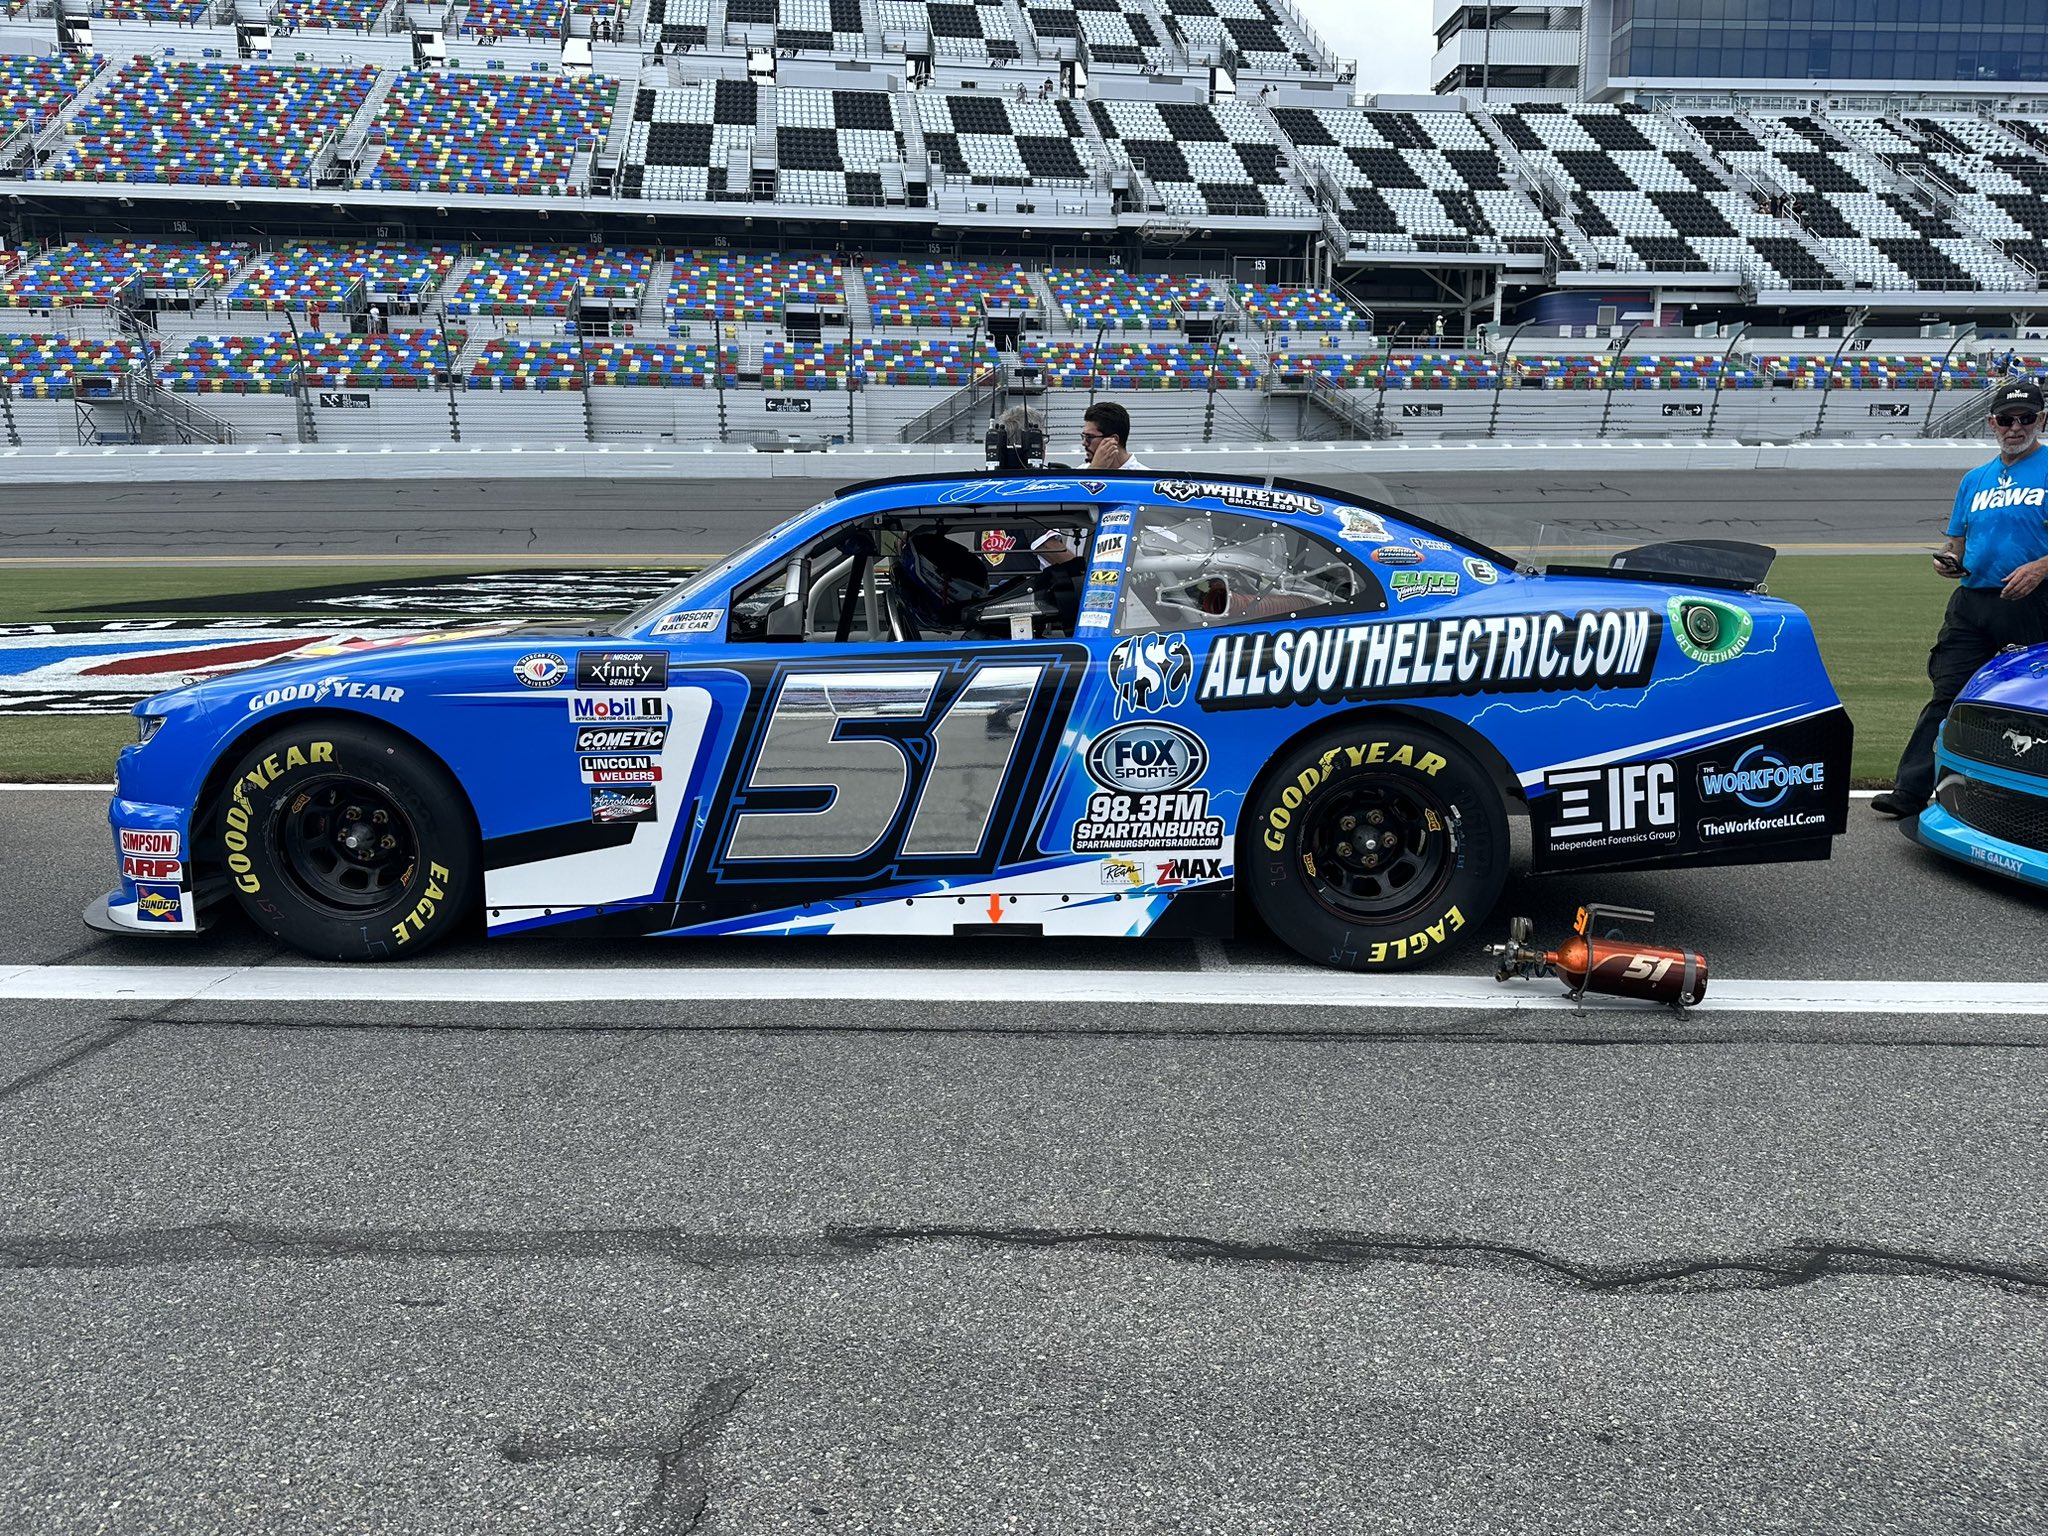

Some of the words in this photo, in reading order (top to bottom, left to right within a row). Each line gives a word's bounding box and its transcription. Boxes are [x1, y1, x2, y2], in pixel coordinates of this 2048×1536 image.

[481, 36, 494, 45] 363
[173, 221, 187, 232] 158
[376, 226, 389, 238] 157
[714, 236, 727, 247] 156
[928, 243, 941, 254] 155
[1109, 255, 1120, 265] 154
[1254, 260, 1266, 271] 153
[1854, 340, 1865, 350] 151
[342, 400, 368, 408] SECTIONS
[1201, 484, 1320, 511] WHITETAIL
[1228, 498, 1293, 511] SMOKELESS
[1971, 487, 2045, 512] Wawa
[1097, 536, 1122, 554] WIX
[1393, 573, 1457, 587] ELITE
[674, 612, 714, 622] NASCAR
[660, 623, 686, 631] RACE
[1201, 611, 1650, 699] ALLSOUTHELECTRIC.COM
[1676, 634, 1692, 652] GET
[1691, 636, 1749, 662] BIOETHANOL
[520, 674, 562, 687] ANNIVERSARY
[591, 662, 652, 682] xfinity
[574, 698, 635, 716] Mobil
[579, 731, 664, 747] COMETIC
[727, 666, 1042, 859] 51
[1115, 740, 1177, 767] FOX
[584, 758, 648, 770] LINCOLN
[1115, 767, 1178, 778] SPORTS
[599, 772, 655, 781] WELDERS
[1703, 763, 1825, 795] WORKFORCE
[592, 794, 654, 808] Arrowhead
[1608, 763, 1675, 831] IFG
[1091, 794, 1204, 822] 98.3FM
[1078, 821, 1219, 839] SPARTANBURG
[1704, 813, 1825, 836] TheWorkforceLLC.com
[123, 832, 172, 852] SIMPSON
[1076, 838, 1219, 849] SPARTANBURGSPORTSRADIO.COM
[1550, 838, 1606, 852] Independent
[1608, 833, 1647, 845] Forensics
[1649, 830, 1676, 842] Group
[124, 857, 180, 878] ARP
[1971, 846, 1986, 859] THE
[1987, 853, 2022, 872] GALAXY
[140, 899, 178, 910] SUNOCO
[391, 861, 449, 945] EAGLE
[1573, 906, 1588, 935] 51
[1368, 905, 1465, 962] EAGLE
[1622, 954, 1674, 982] 51
